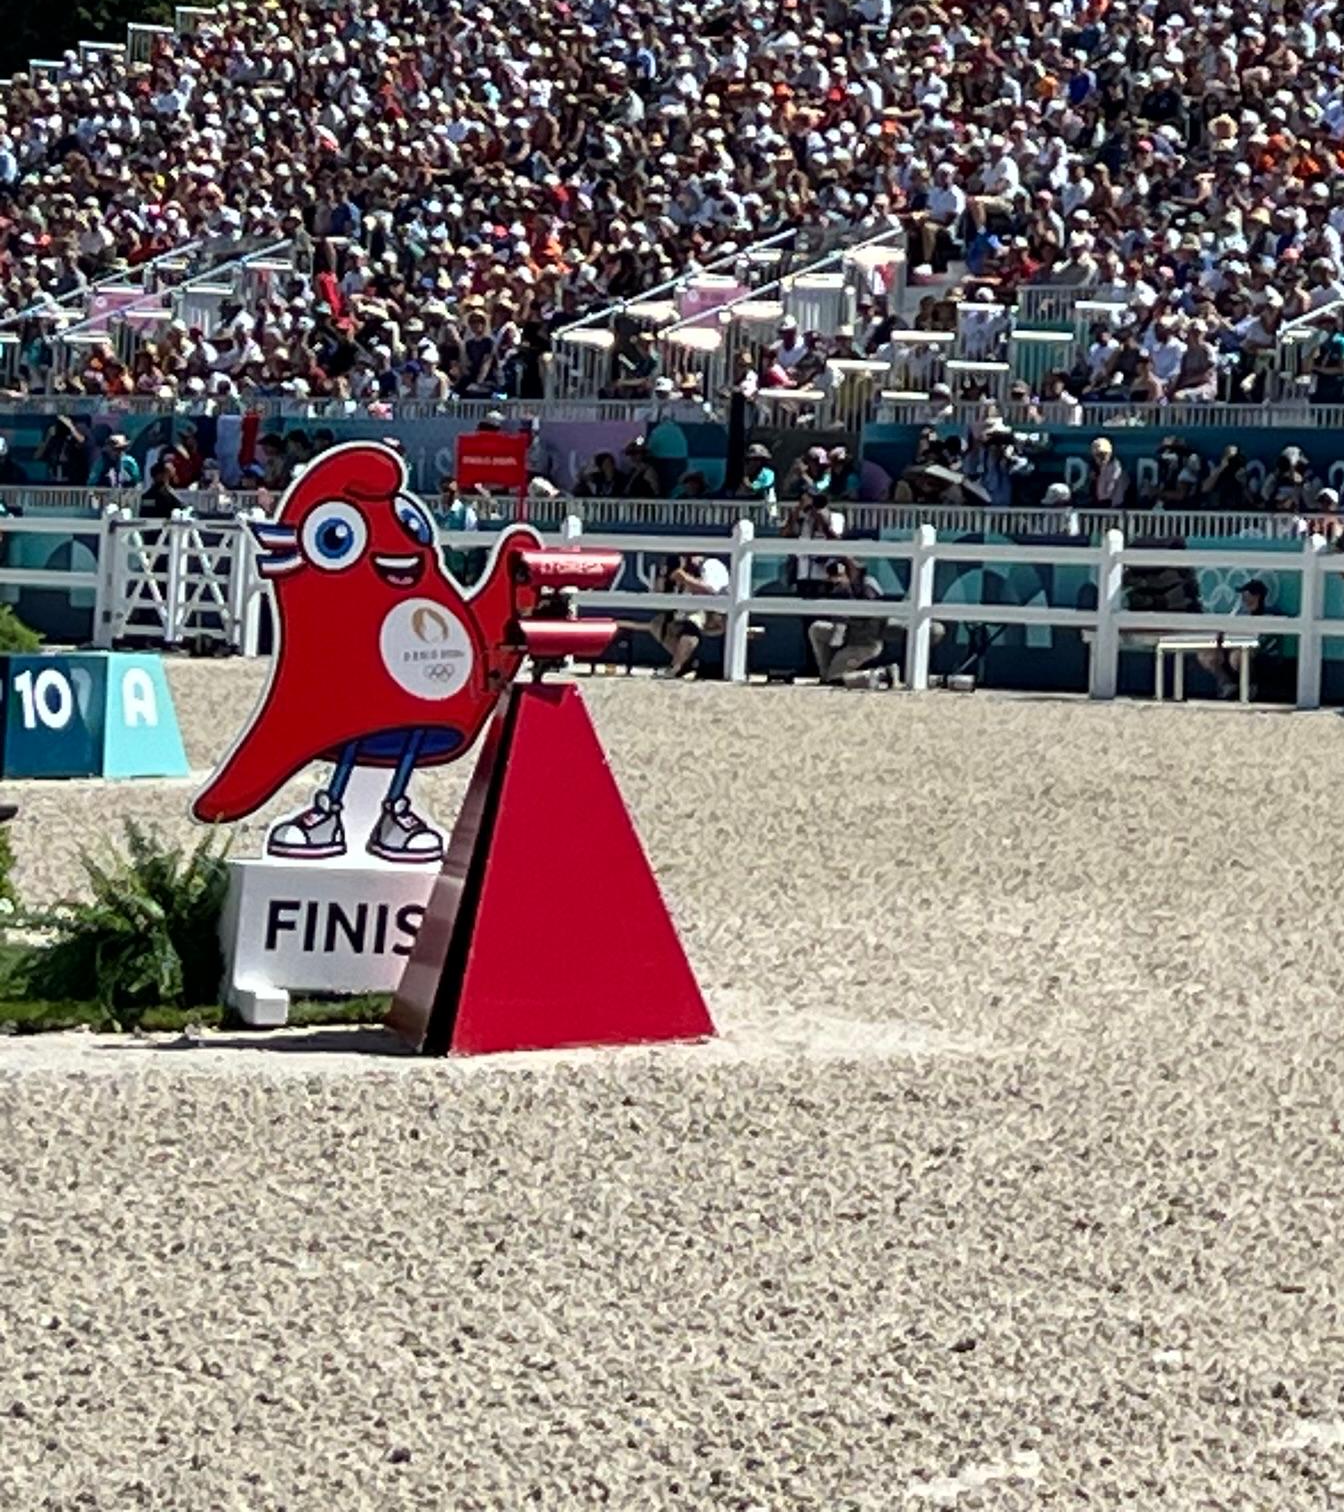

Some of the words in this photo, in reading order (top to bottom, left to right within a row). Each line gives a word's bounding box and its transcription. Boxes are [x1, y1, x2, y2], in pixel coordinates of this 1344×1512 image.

[14, 668, 73, 729] 10
[122, 667, 159, 728] A
[265, 900, 427, 956] FINIS
